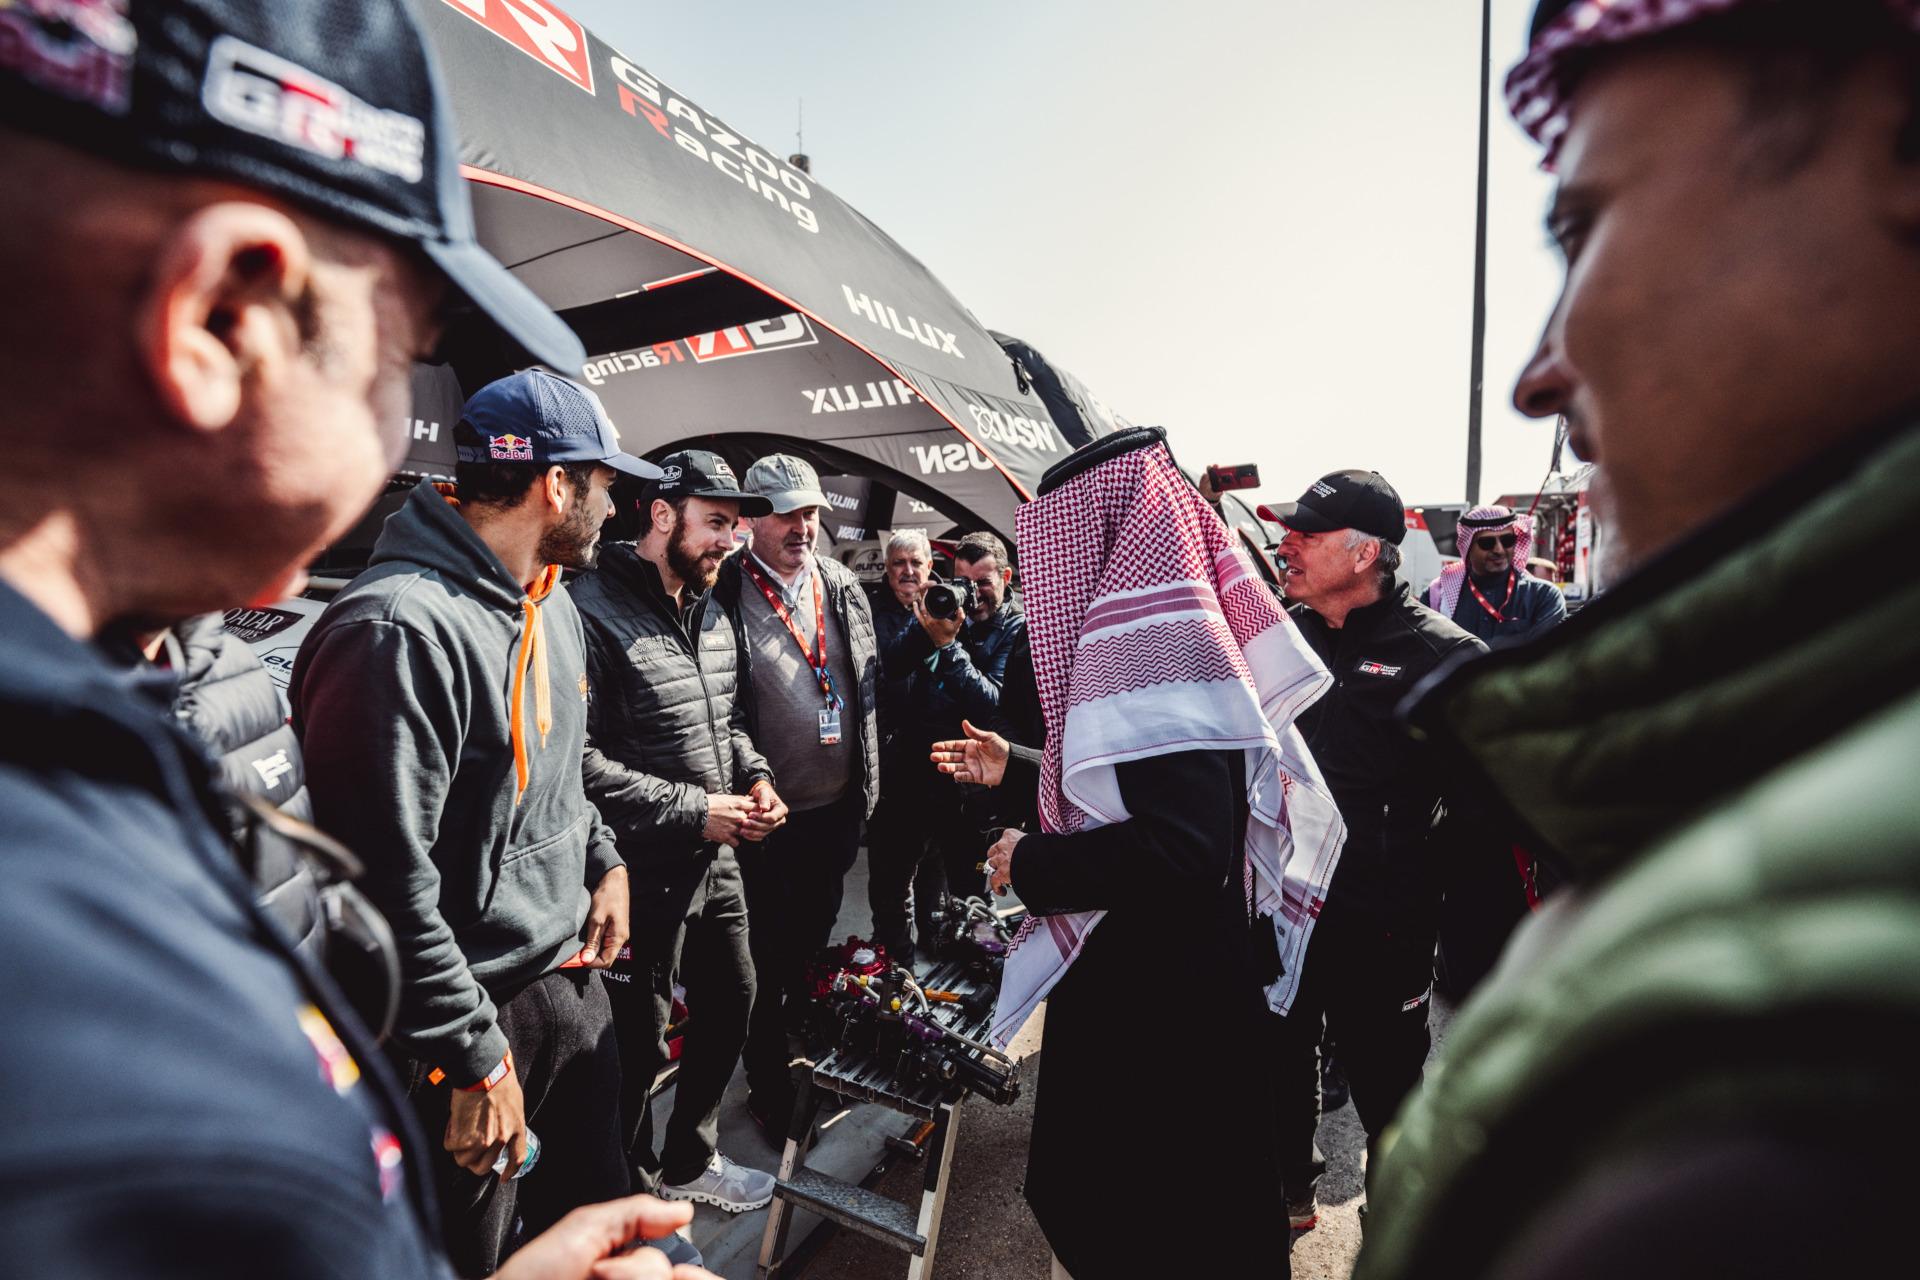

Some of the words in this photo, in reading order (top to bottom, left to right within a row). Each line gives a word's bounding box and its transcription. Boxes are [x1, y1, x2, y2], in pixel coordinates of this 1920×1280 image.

[610, 56, 811, 199] GAZOO
[616, 83, 819, 233] Racing
[841, 284, 965, 359] HILUX
[992, 411, 1057, 452] USN
[855, 562, 885, 571] euro
[600, 969, 632, 983] HILUX
